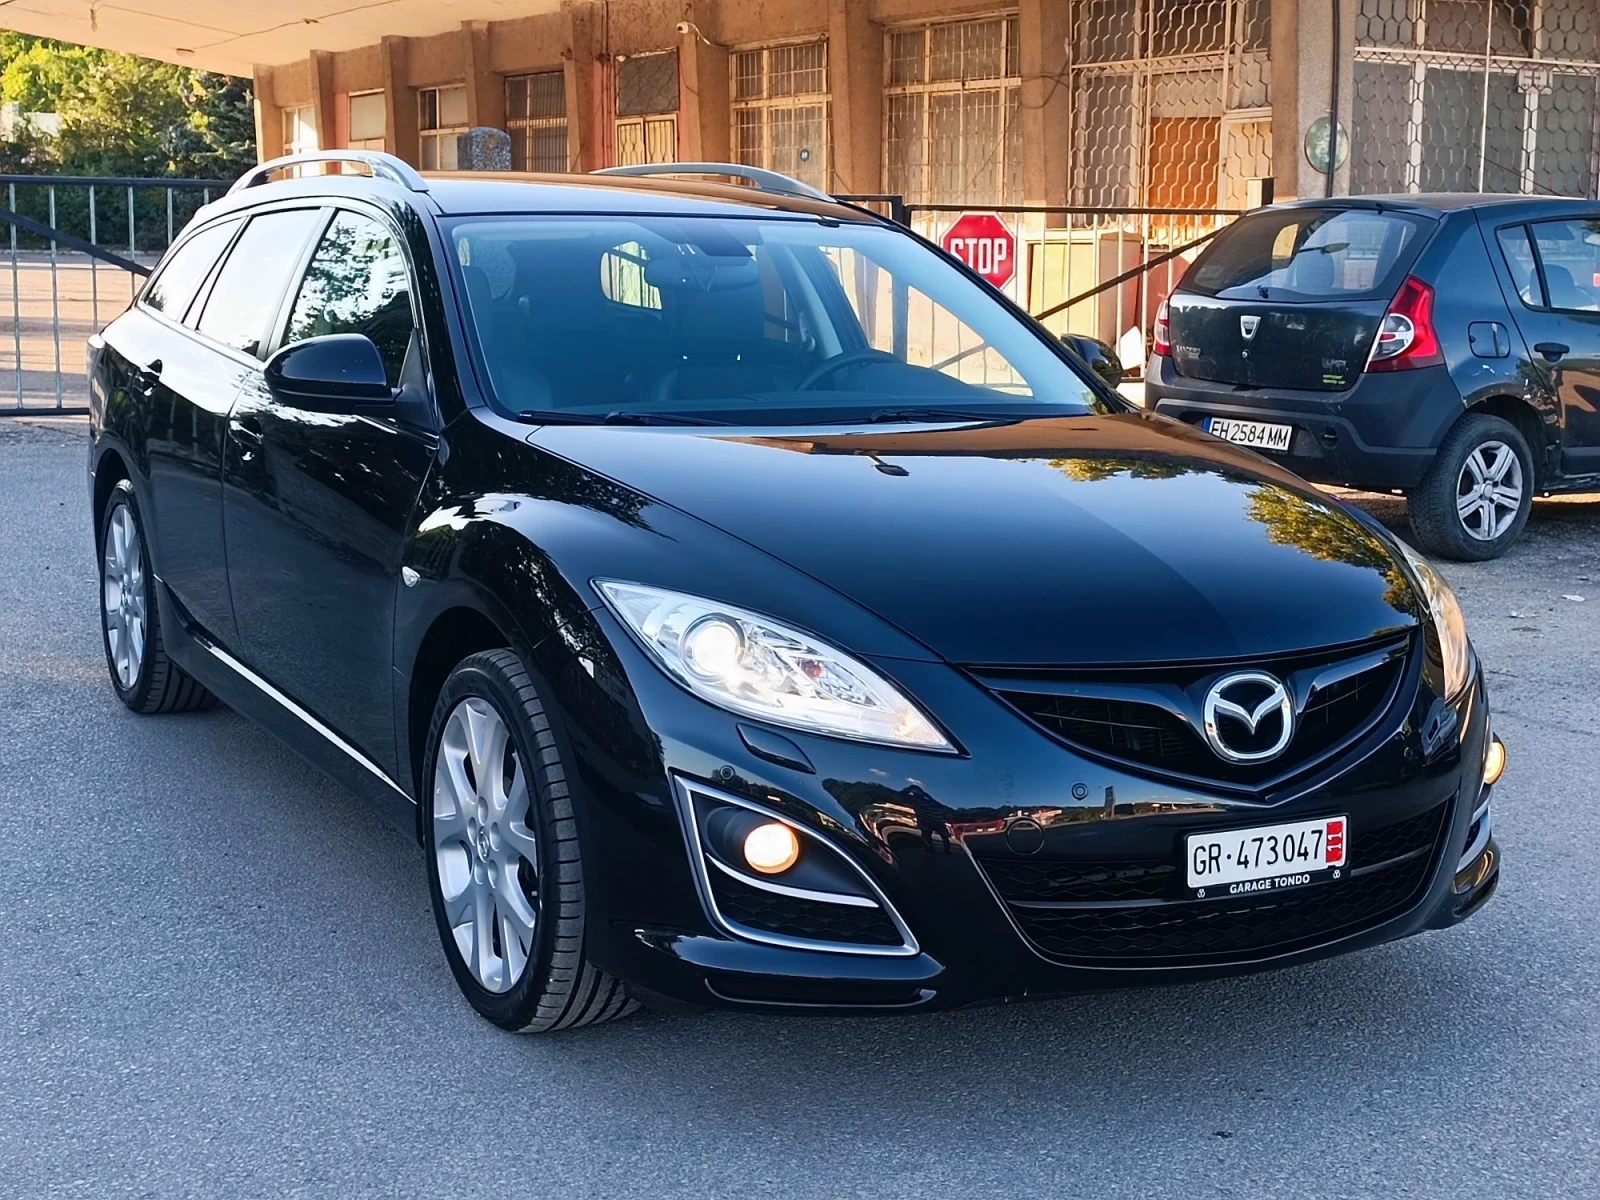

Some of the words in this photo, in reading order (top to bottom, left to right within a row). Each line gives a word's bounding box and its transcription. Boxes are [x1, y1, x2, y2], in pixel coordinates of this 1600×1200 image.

[950, 238, 1007, 274] STOP
[1229, 879, 1272, 894] GARAGE
[1275, 873, 1311, 887] TONDO
